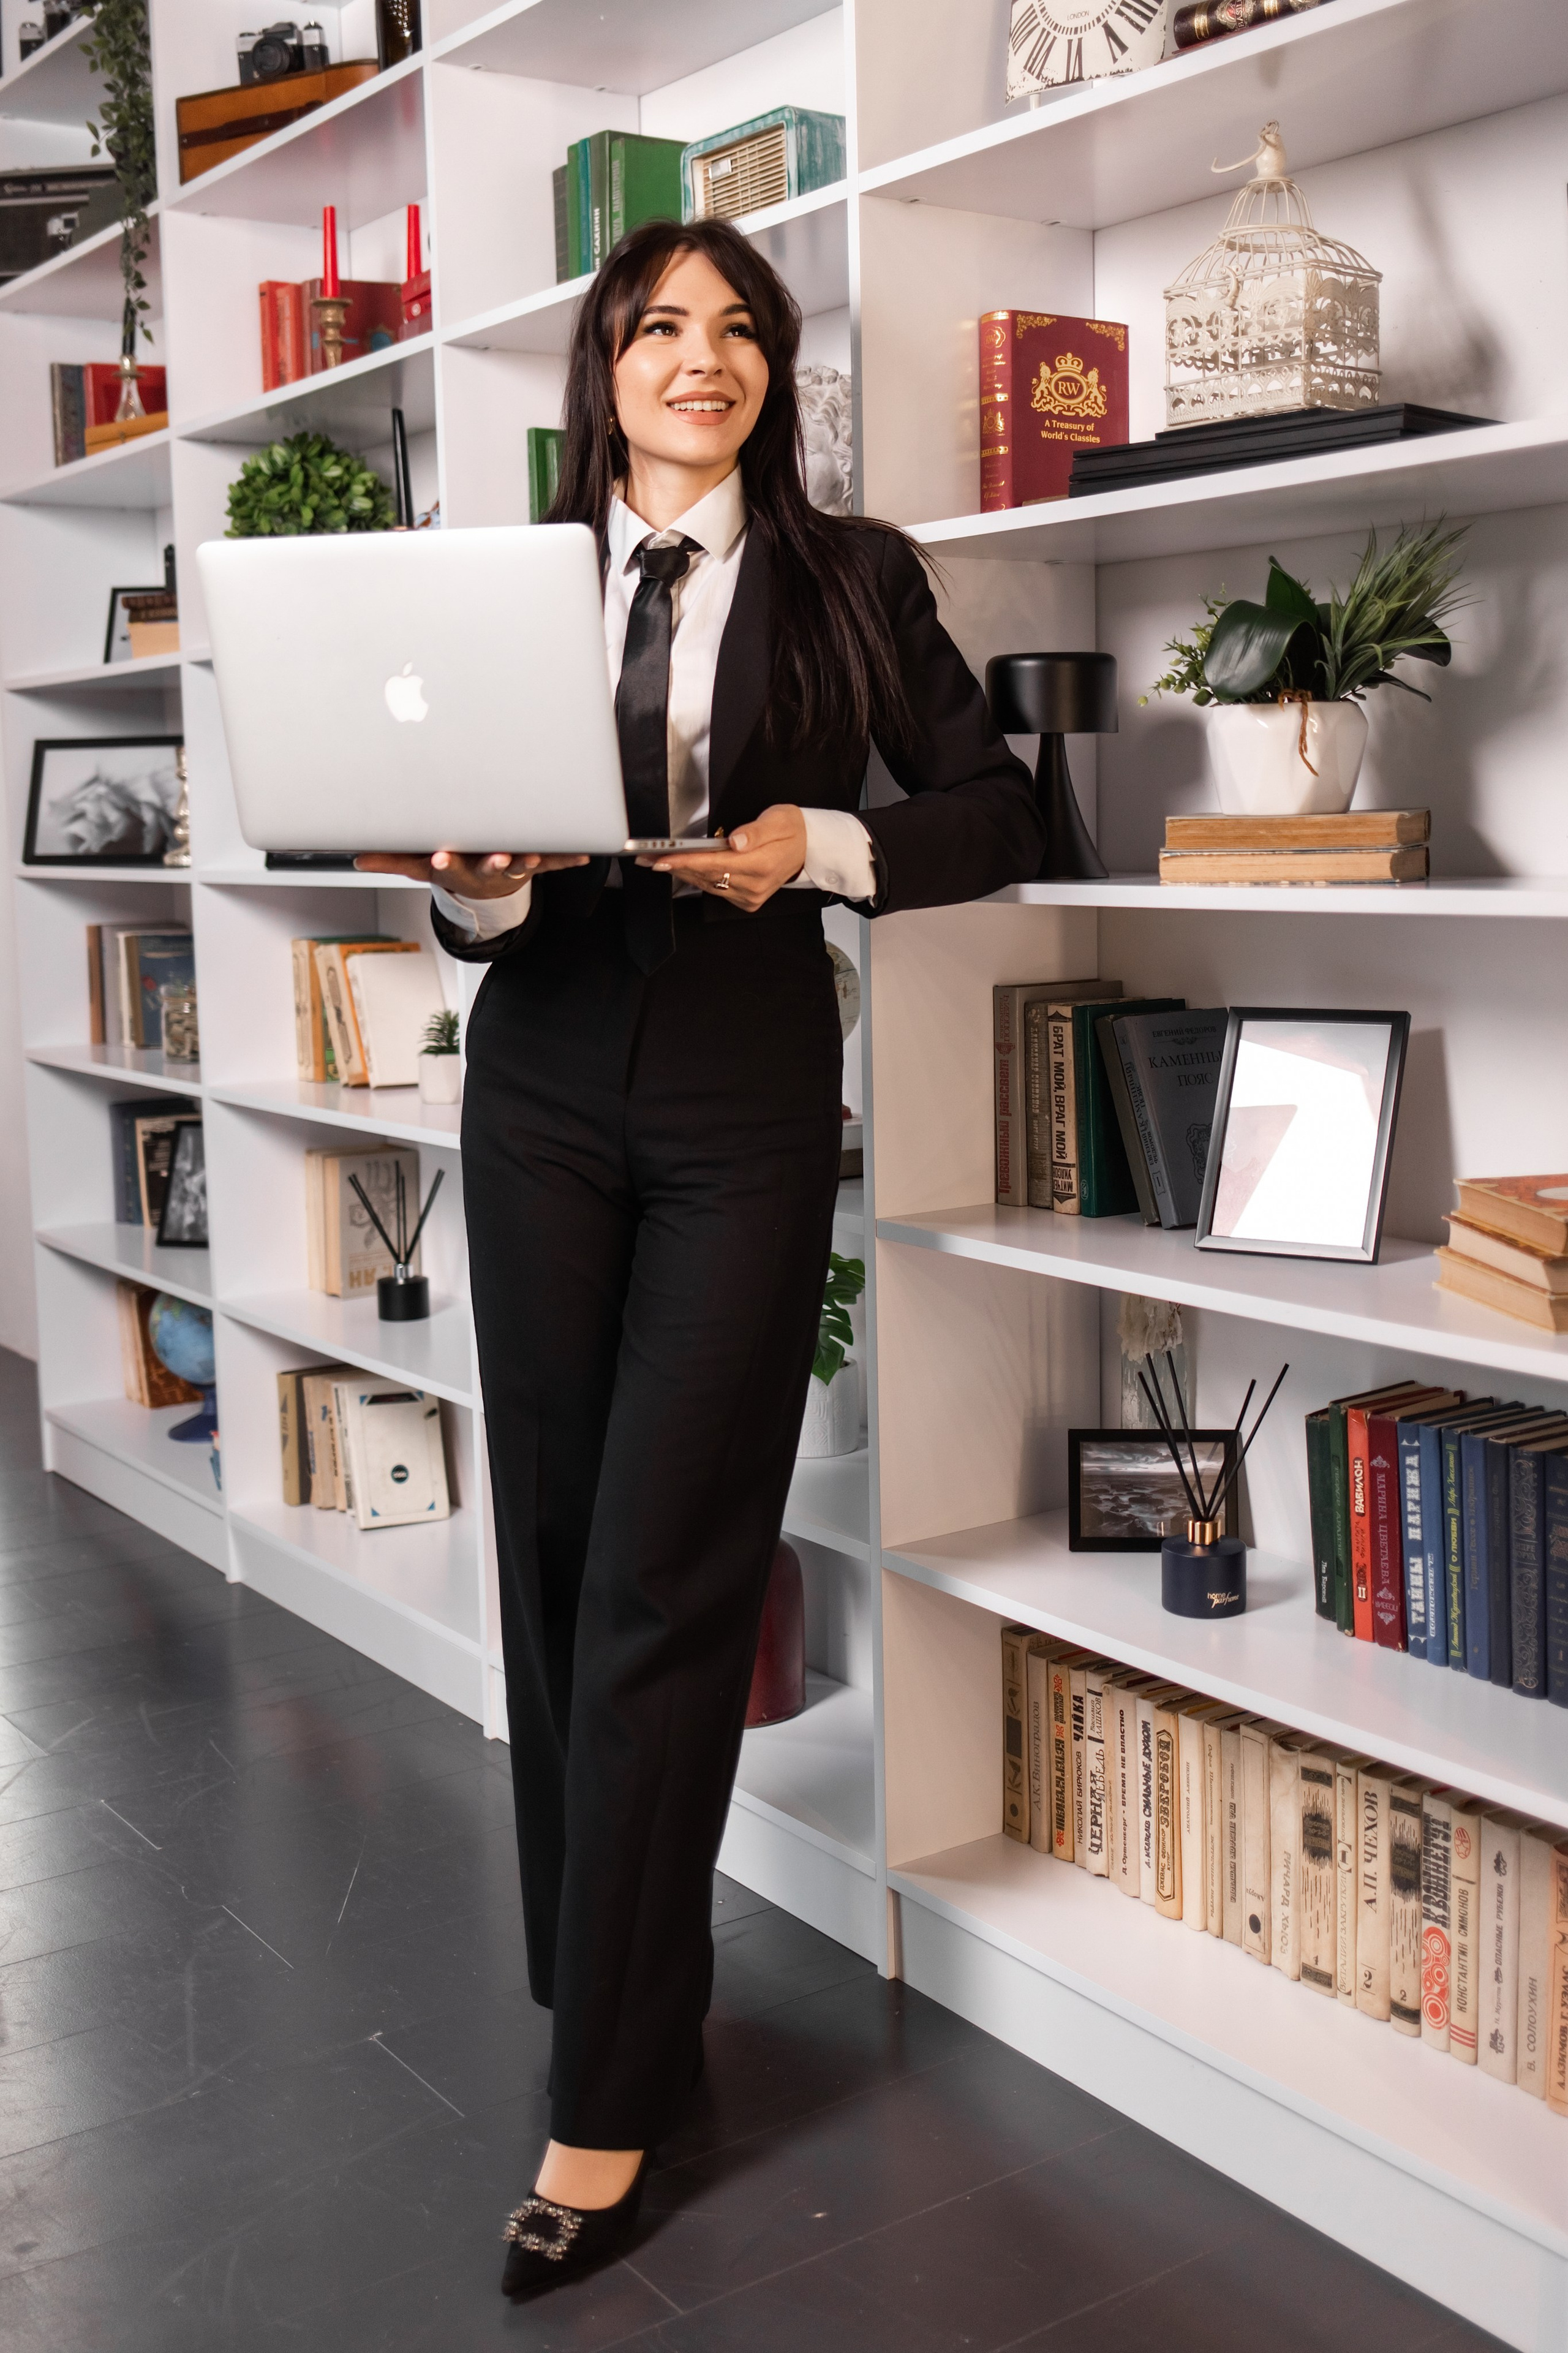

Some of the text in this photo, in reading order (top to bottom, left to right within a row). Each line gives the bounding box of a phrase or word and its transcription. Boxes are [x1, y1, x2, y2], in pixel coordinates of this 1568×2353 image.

[1067, 10, 1090, 21] LONDON
[1058, 381, 1080, 396] RW
[1041, 431, 1069, 440] World's
[1052, 420, 1085, 432] Treasury
[1087, 423, 1095, 431] of
[1152, 1028, 1184, 1038] ЕВГЕНИЙ
[1148, 1051, 1224, 1068] КАМЕННЫ
[1053, 1026, 1067, 1160] БРАТ МОЙ, ВРАГ МОЙ
[1135, 1082, 1146, 1108] ПОЯС
[1177, 1072, 1213, 1087] ПОЯС
[1141, 1133, 1154, 1165] ЕВГЕНИЙ
[1354, 1460, 1365, 1513] ВАВИЛОН
[1377, 1473, 1390, 1584] МАРИНА ЦВЕТАЕВА
[1405, 1454, 1425, 1624] ТАЙНЫ ПАРИЖА
[1212, 1592, 1239, 1609] parfume
[1072, 1694, 1084, 1742] ЧАЙКА
[1095, 1749, 1106, 1803] ЛЕБЕДЬ
[1121, 1758, 1126, 1769] НЕ
[1142, 1720, 1153, 1818] СИЛЬНЫЕ ДУХОМ
[1159, 1739, 1170, 1828] ЗВЕРОБОЙ
[1364, 1791, 1378, 1864] ЧЕХОВ
[1280, 1851, 1291, 1954] РИЧАРД ХЬЮЗ
[1457, 1888, 1469, 2013] КОНСТАНТИН СИМОНОВ
[1363, 1970, 1373, 1989] 2
[1400, 1989, 1407, 2001] 2
[1527, 1976, 1537, 2072] В. СОЛОУХИН
